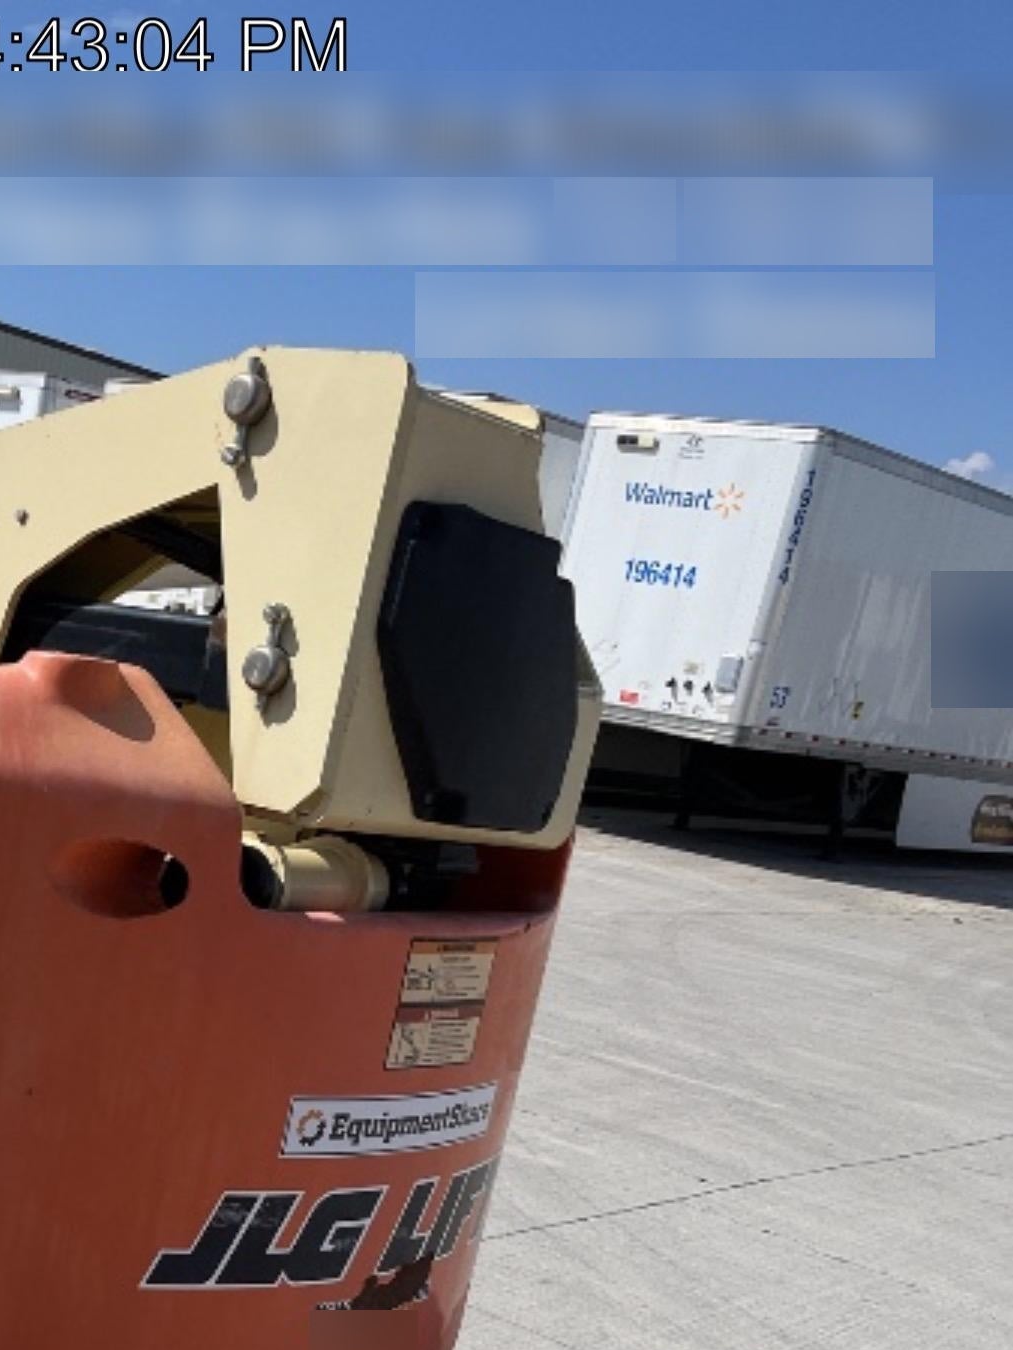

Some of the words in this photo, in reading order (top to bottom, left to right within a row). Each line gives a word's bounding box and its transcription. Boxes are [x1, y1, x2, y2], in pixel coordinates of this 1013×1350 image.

[624, 482, 714, 511] Walmart
[624, 558, 698, 589] 196414
[139, 1185, 389, 1289] JLG
